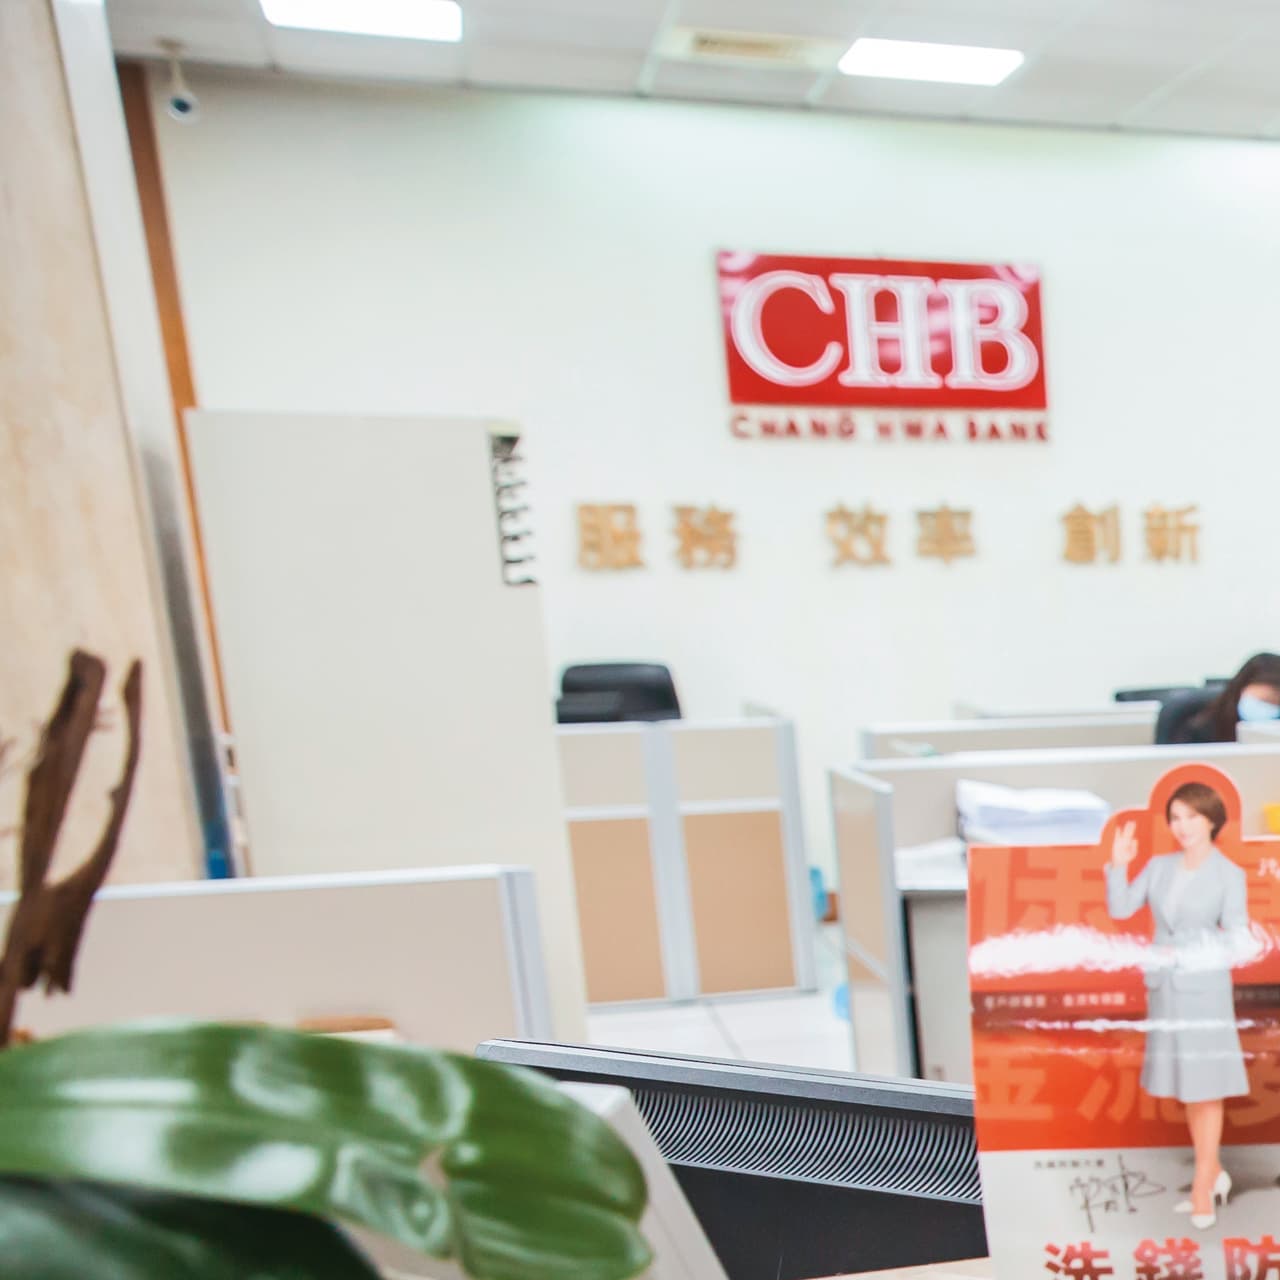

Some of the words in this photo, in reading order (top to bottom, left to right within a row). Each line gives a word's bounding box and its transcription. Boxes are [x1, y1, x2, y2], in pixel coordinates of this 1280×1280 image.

[730, 268, 1040, 392] CHB
[575, 502, 739, 571] 服務
[825, 502, 977, 567] 效率
[1059, 502, 1199, 565] 創新
